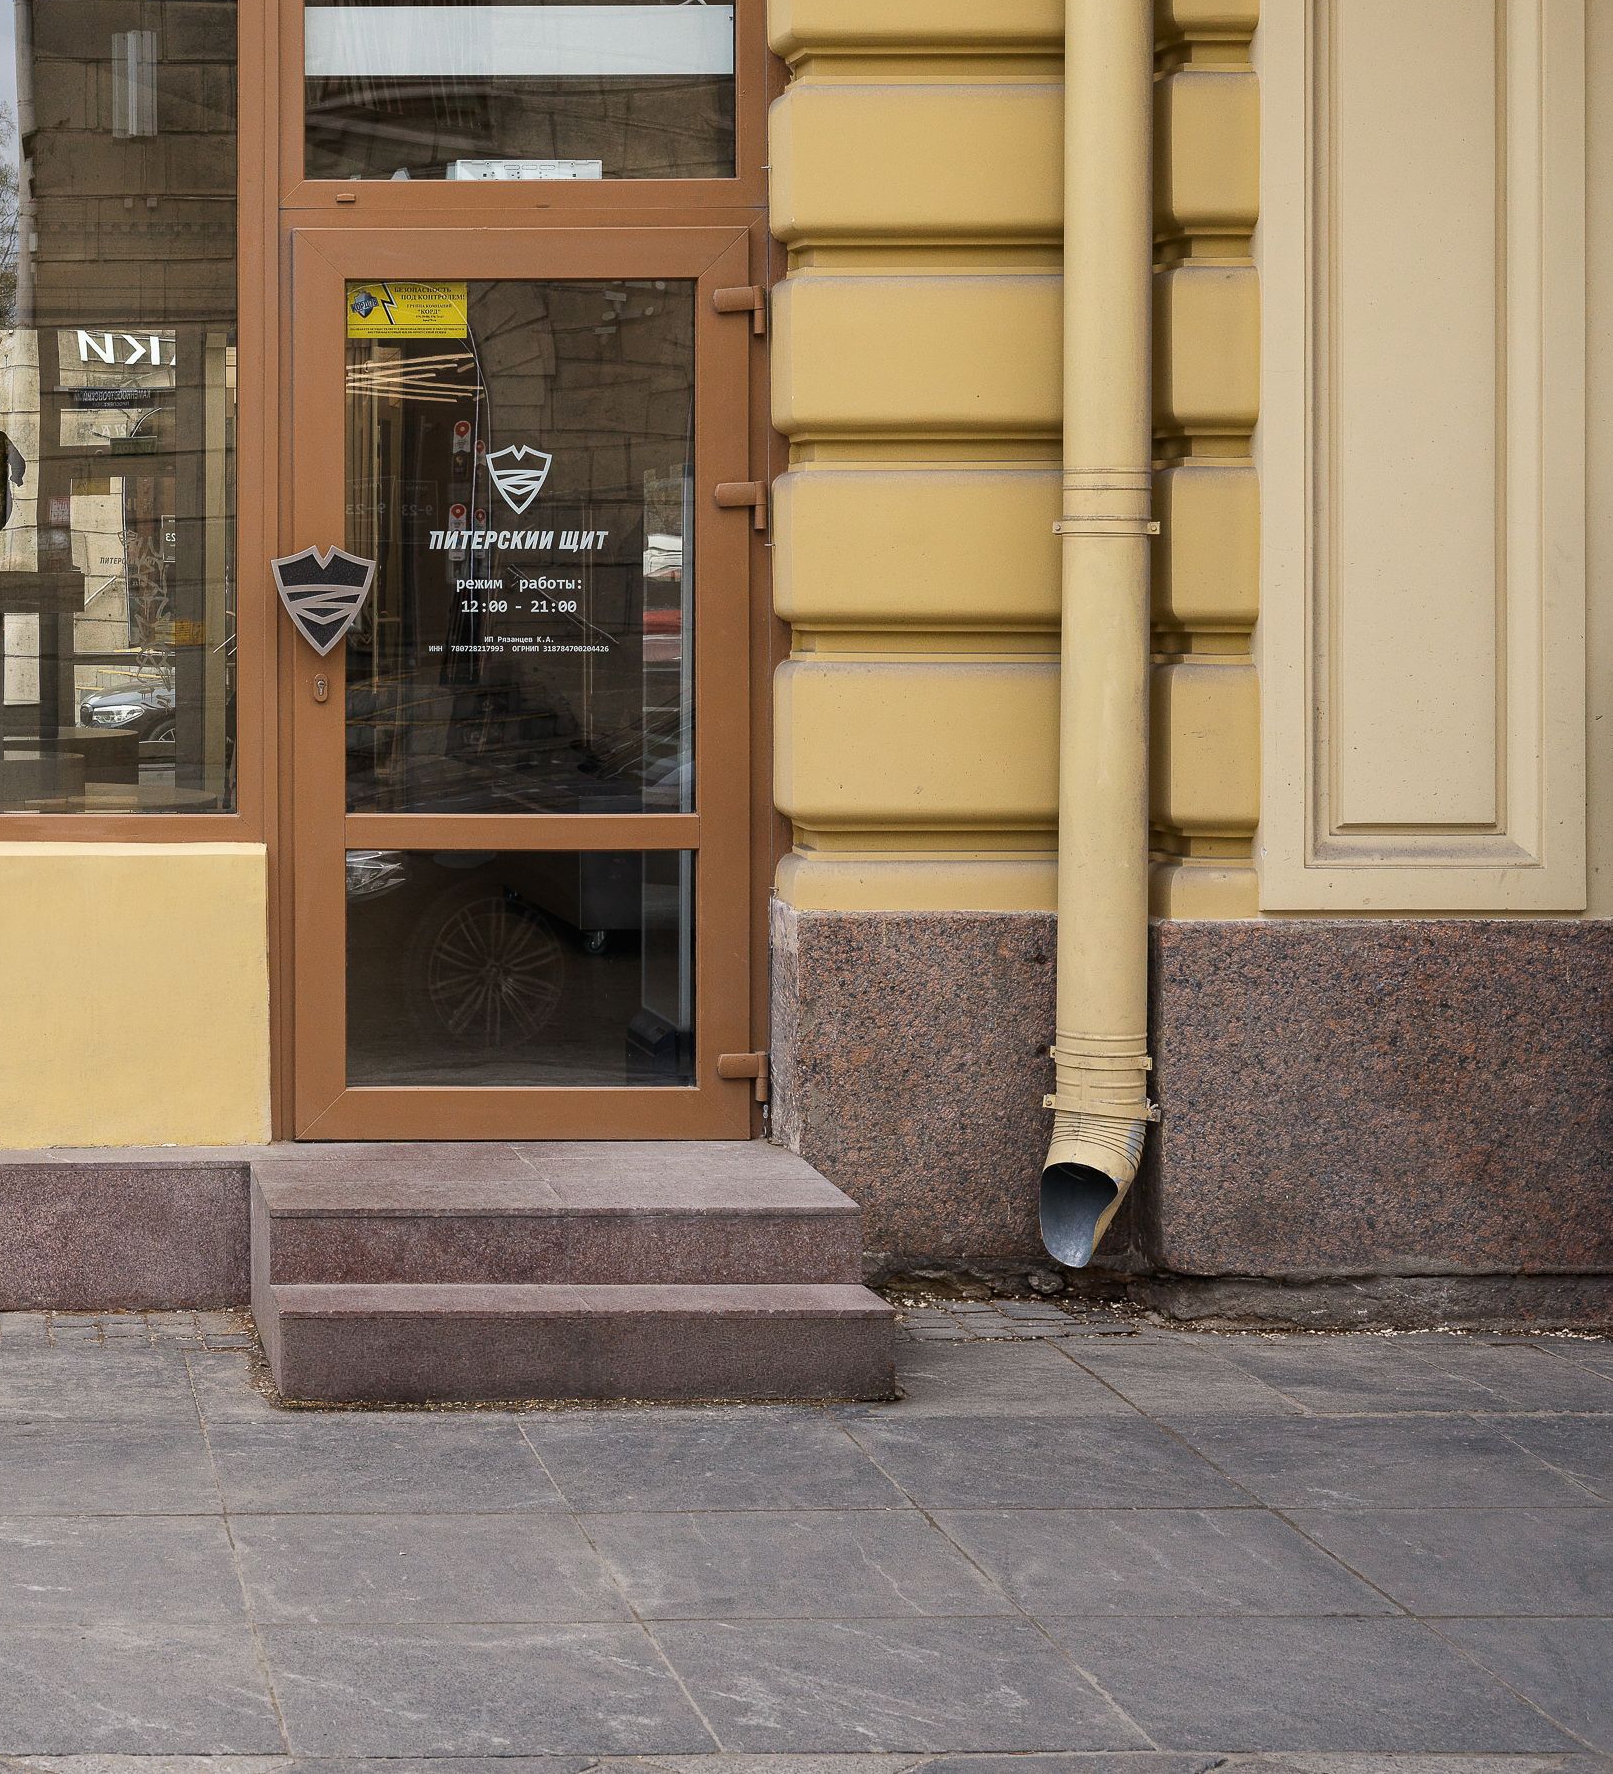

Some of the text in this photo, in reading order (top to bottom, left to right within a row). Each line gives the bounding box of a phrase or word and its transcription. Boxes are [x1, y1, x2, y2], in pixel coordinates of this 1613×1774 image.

[559, 530, 609, 553] ЩИТ
[456, 576, 583, 592] режим работы:
[461, 600, 508, 613] 12:00
[530, 600, 577, 613] 21:00
[497, 636, 533, 644] Рязанцев
